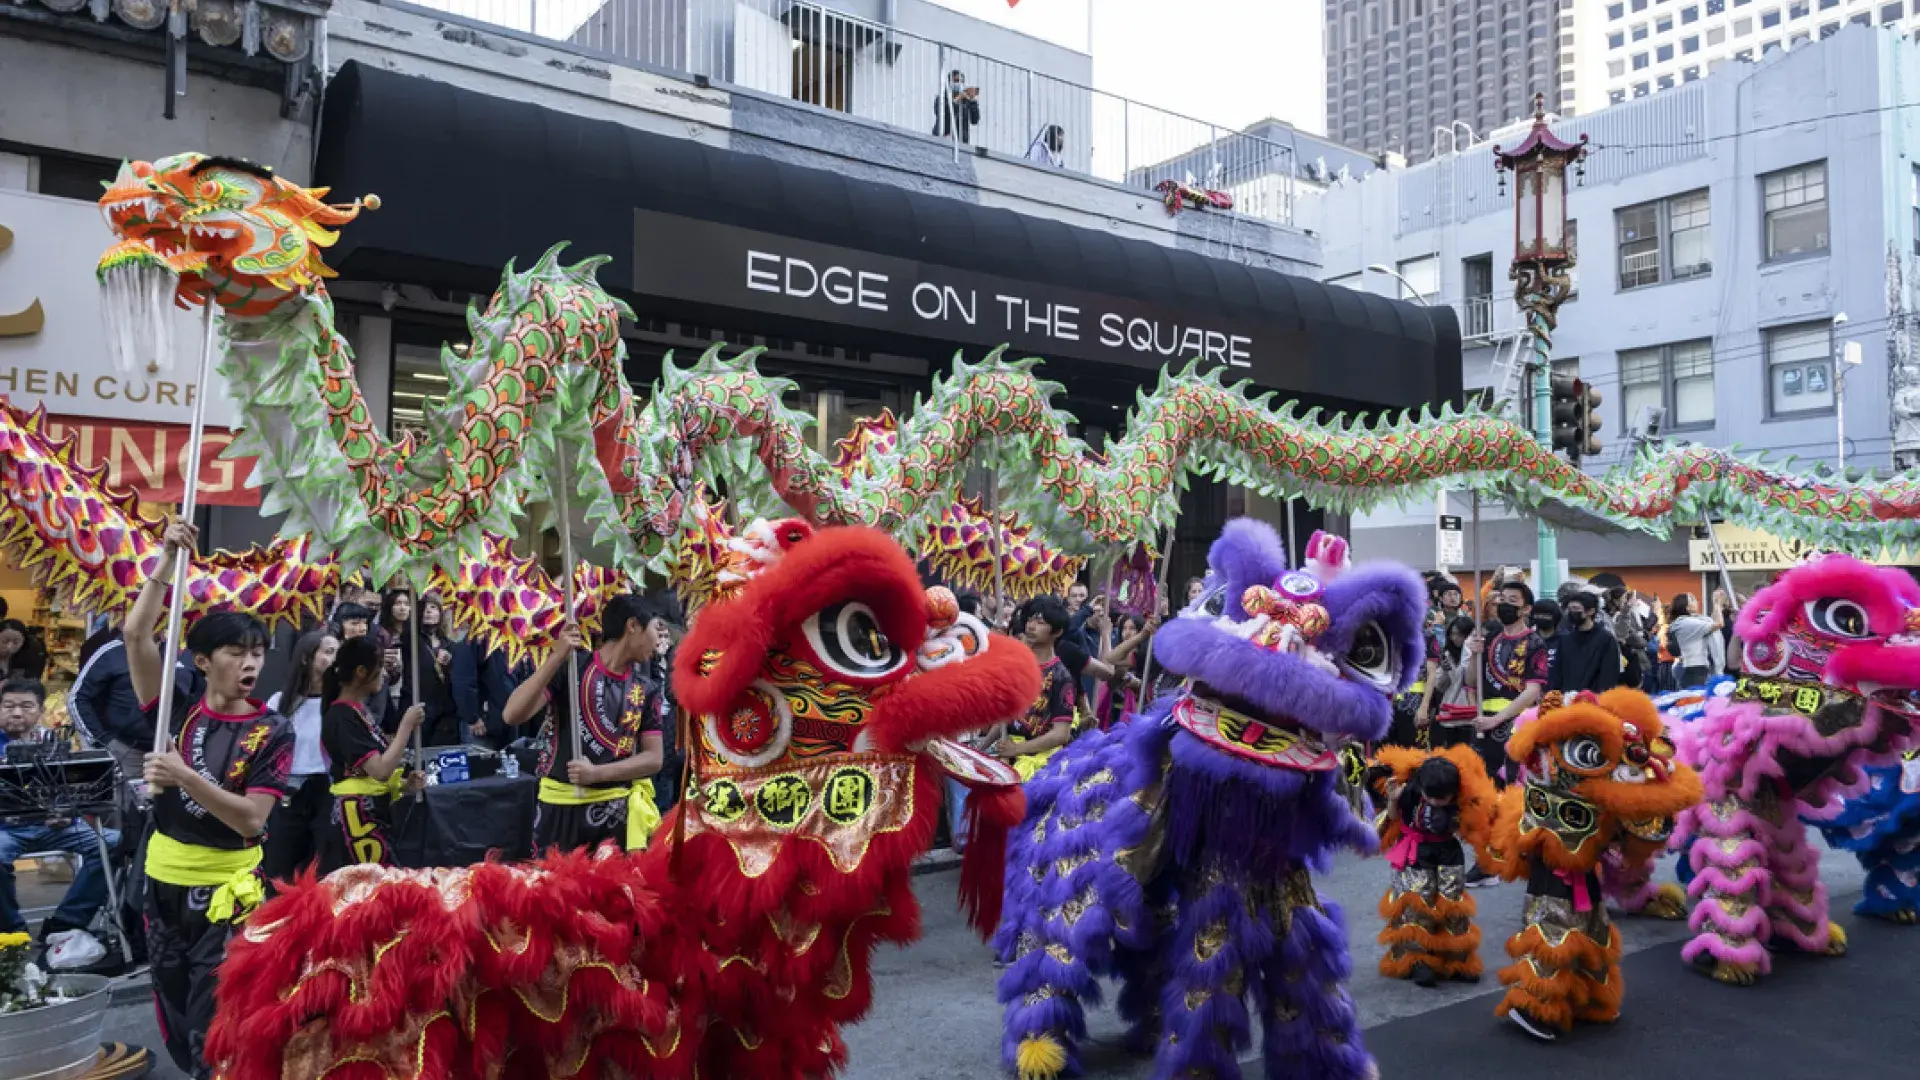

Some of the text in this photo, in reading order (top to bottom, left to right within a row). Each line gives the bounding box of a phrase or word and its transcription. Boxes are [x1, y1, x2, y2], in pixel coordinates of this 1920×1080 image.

[746, 250, 1252, 368] EDGE ON THE SQUARE
[1701, 550, 1781, 565] MATCHA
